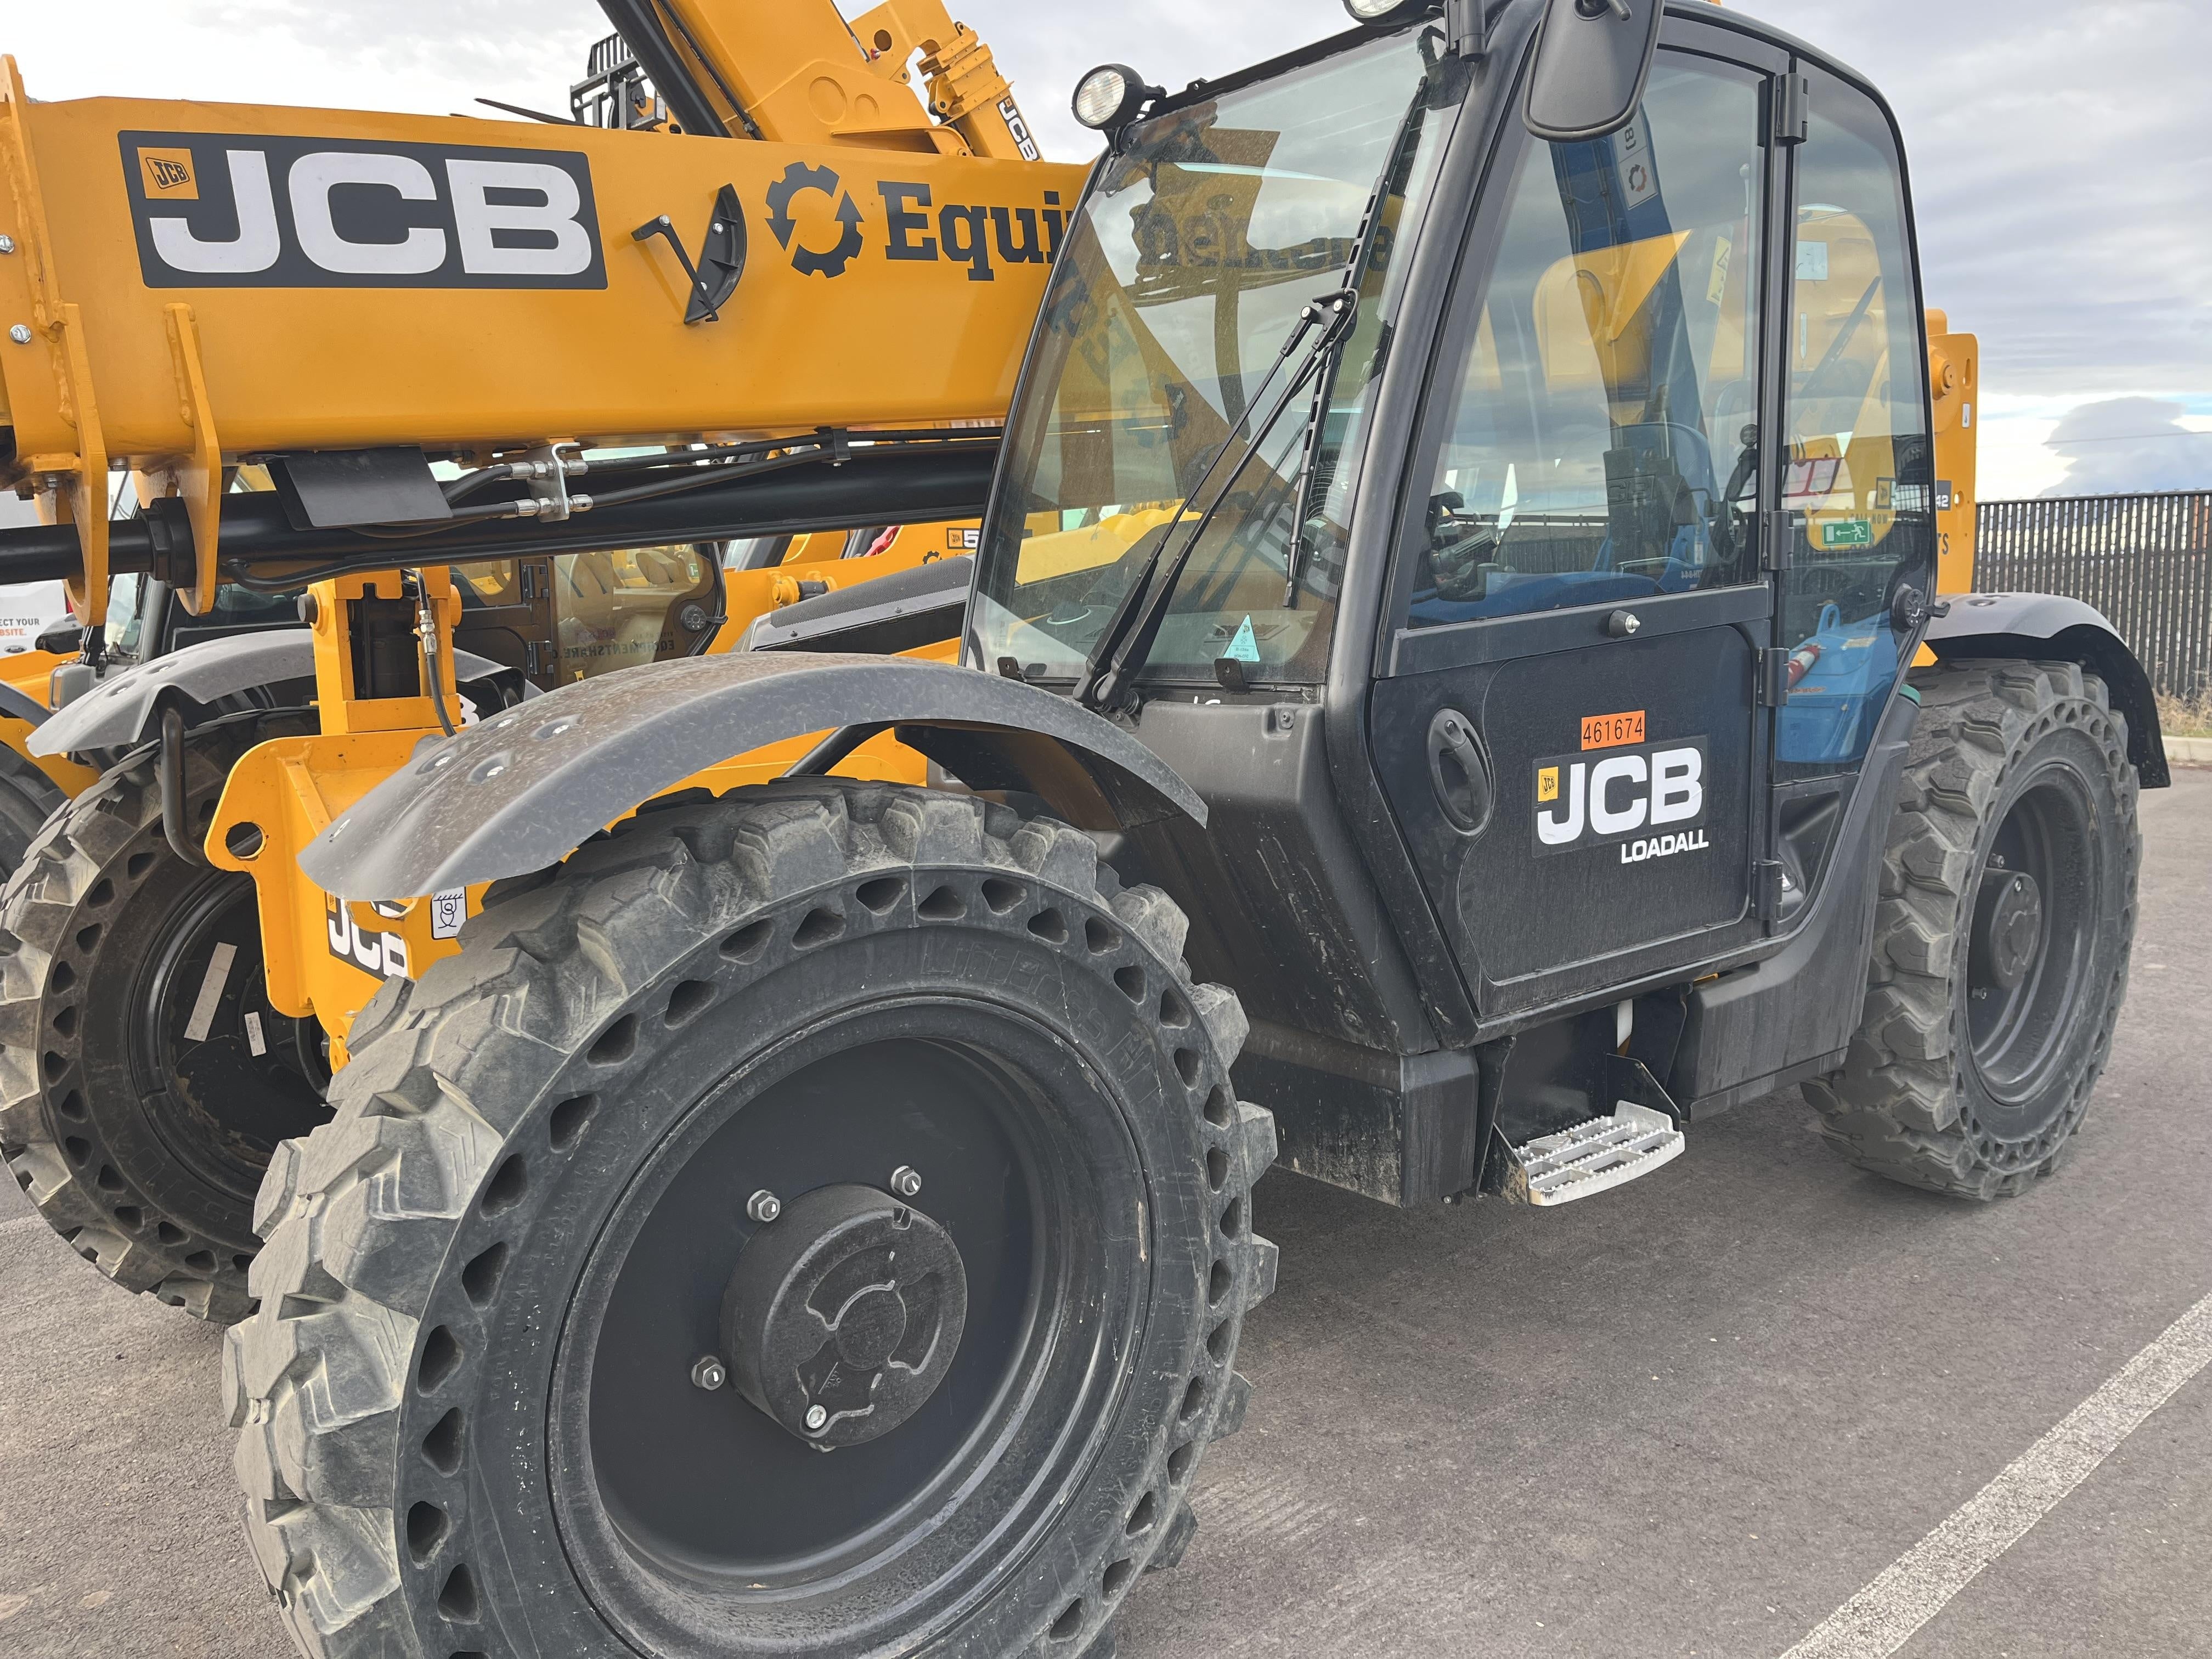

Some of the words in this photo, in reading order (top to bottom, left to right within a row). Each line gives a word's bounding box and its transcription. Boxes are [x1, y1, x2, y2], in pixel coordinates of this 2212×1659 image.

[999, 101, 1038, 161] JCB
[153, 161, 187, 185] JCB
[149, 149, 592, 274] JCB
[1583, 716, 1644, 744] 461674
[1537, 747, 1702, 845] JCB
[1543, 776, 1555, 792] JCB
[1621, 829, 1709, 864] LOADALL
